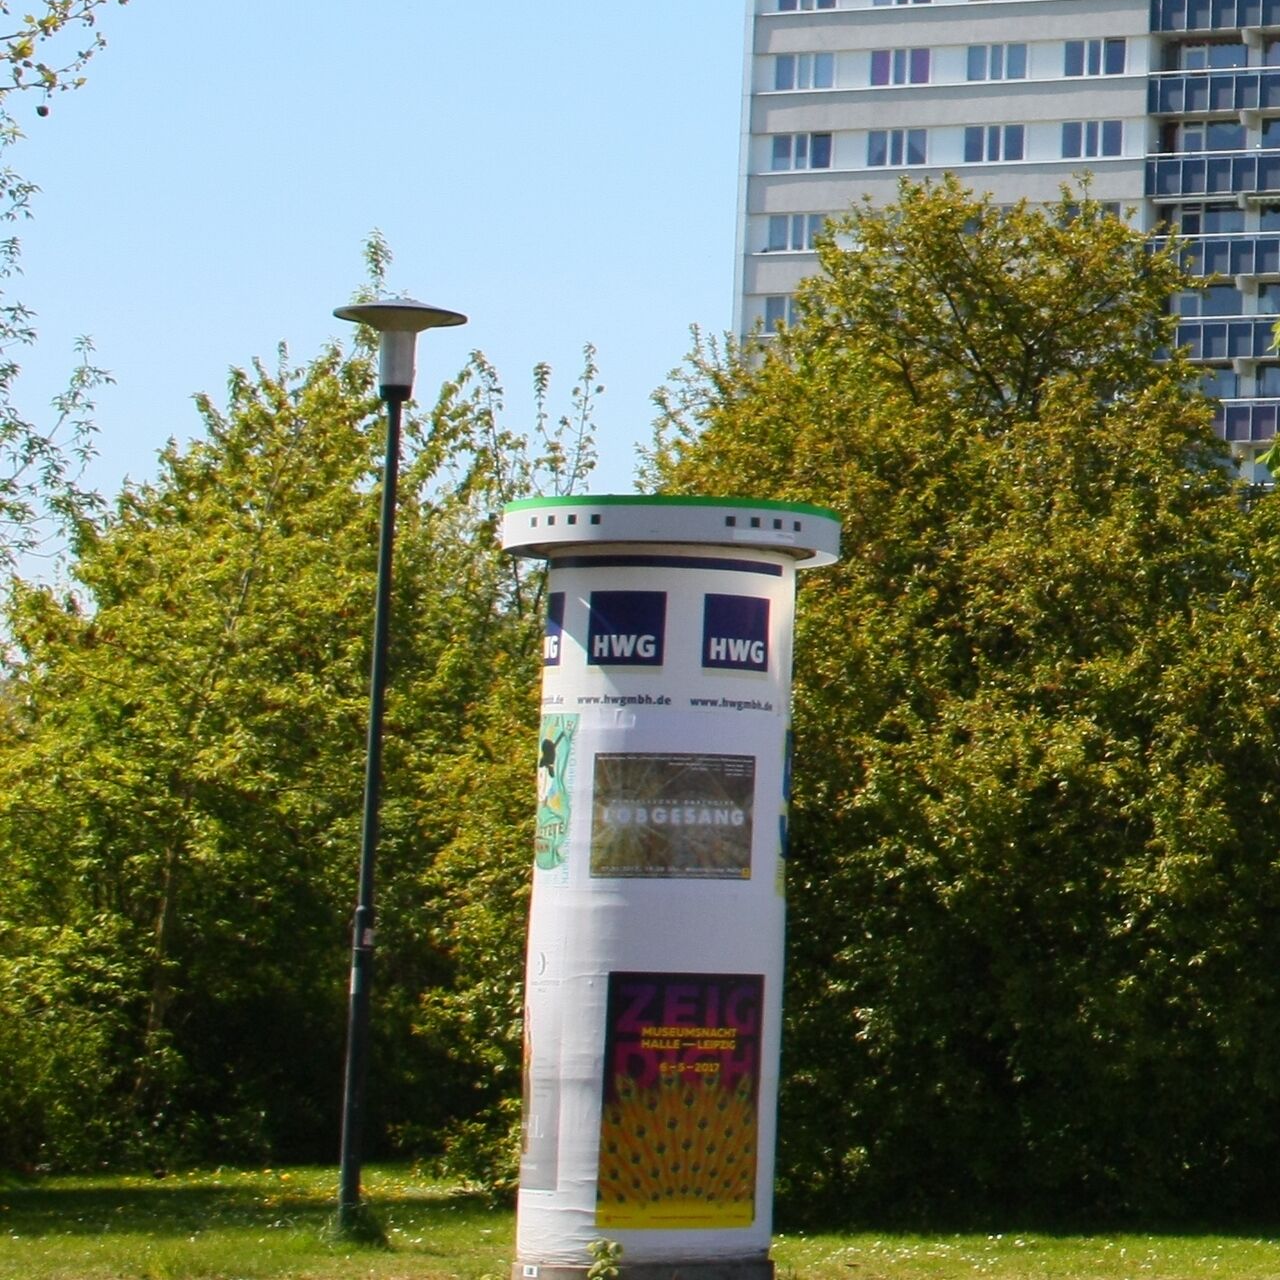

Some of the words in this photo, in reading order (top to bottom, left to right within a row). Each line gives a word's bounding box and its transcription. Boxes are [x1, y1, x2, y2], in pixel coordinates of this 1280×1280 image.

[593, 634, 656, 658] HWG
[709, 637, 765, 664] HWG
[577, 694, 671, 707] www.hwgmbh.de
[690, 697, 773, 712] www.hwgmbh.de
[603, 806, 745, 827] LOBGESANG
[616, 984, 757, 1036] ZEIG
[641, 1026, 737, 1038] MUSEUMSNACHT
[641, 1038, 681, 1050] HALLE
[697, 1039, 736, 1051] LEIPZIG
